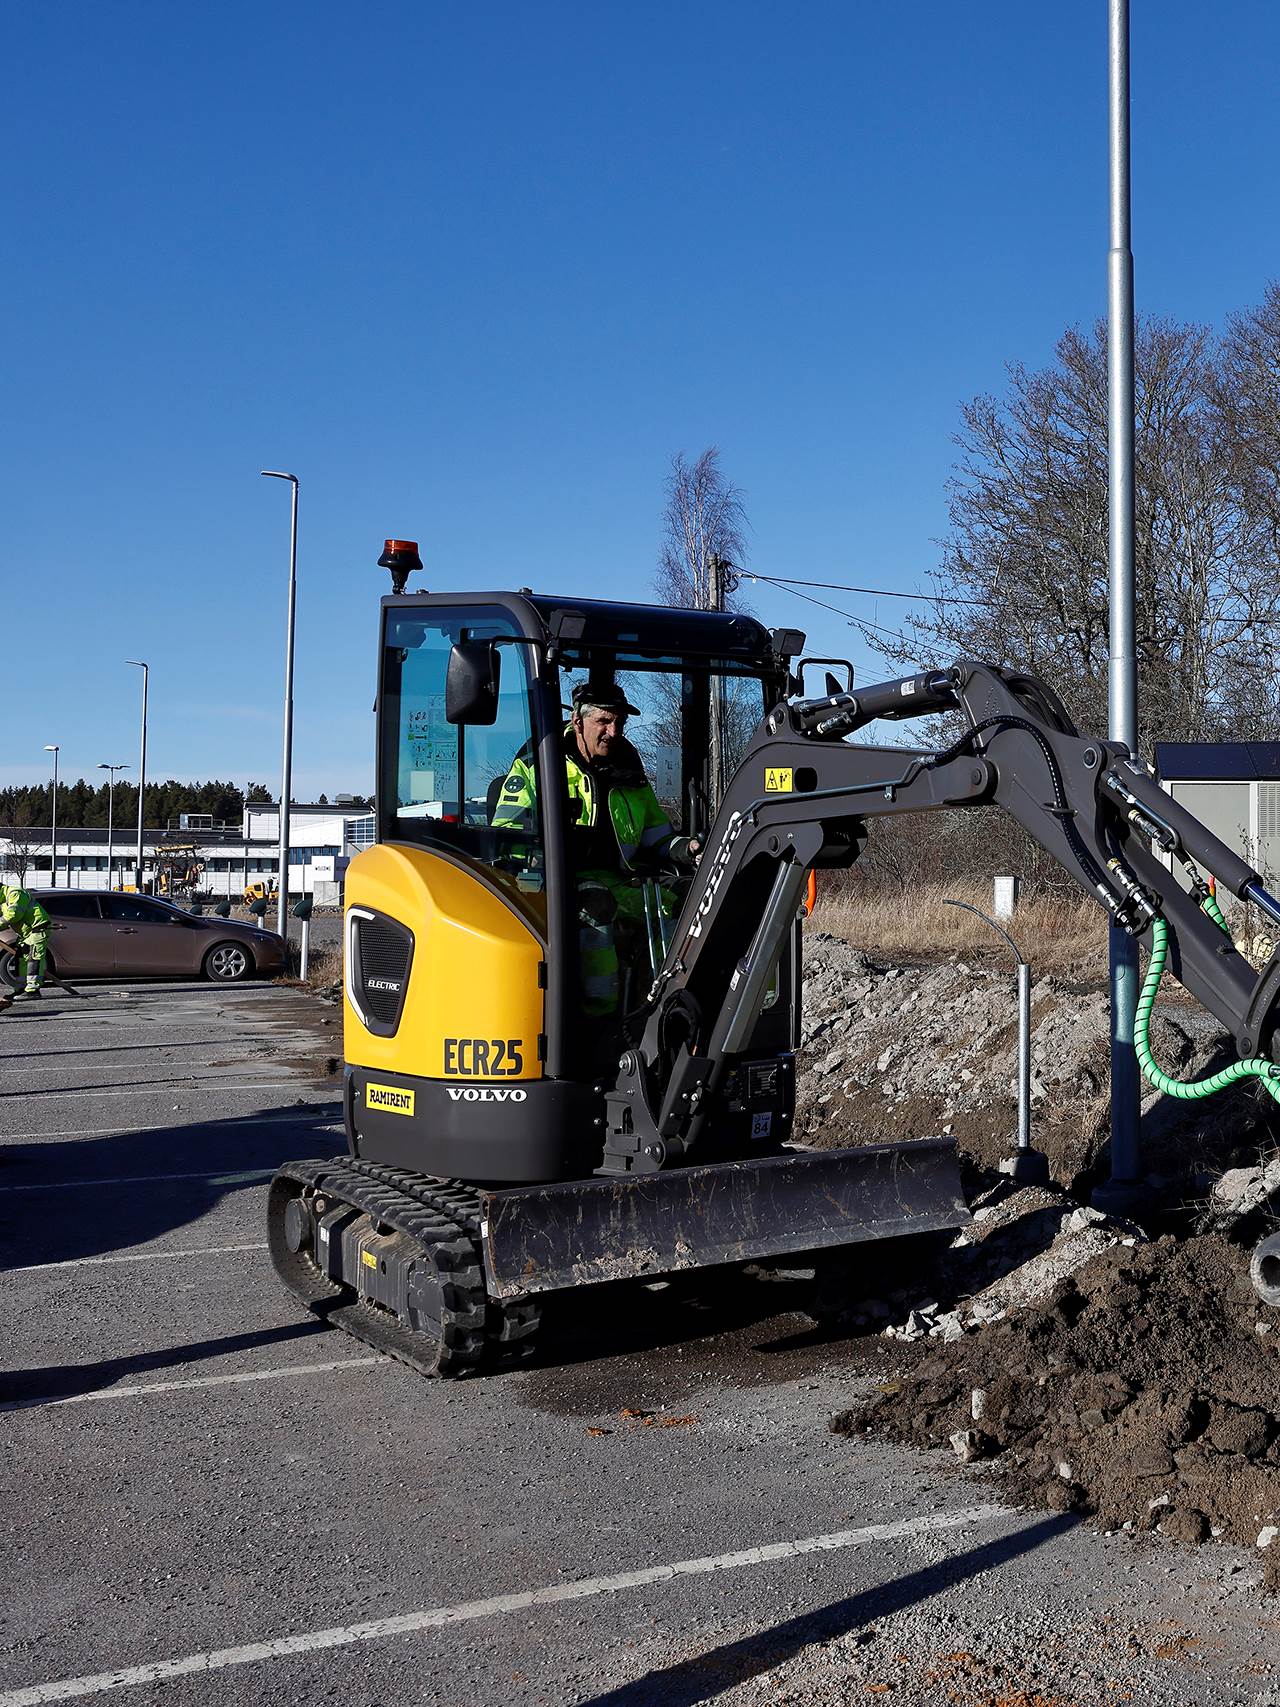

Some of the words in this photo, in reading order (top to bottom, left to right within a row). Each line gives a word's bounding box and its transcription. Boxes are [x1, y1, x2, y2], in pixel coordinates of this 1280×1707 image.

[687, 811, 742, 938] VOLVO
[368, 979, 401, 991] ELECTRIC
[444, 1038, 523, 1076] ECR25
[369, 1089, 412, 1109] RAMIRENT
[446, 1088, 528, 1102] VOLVO
[753, 1121, 769, 1135] 84
